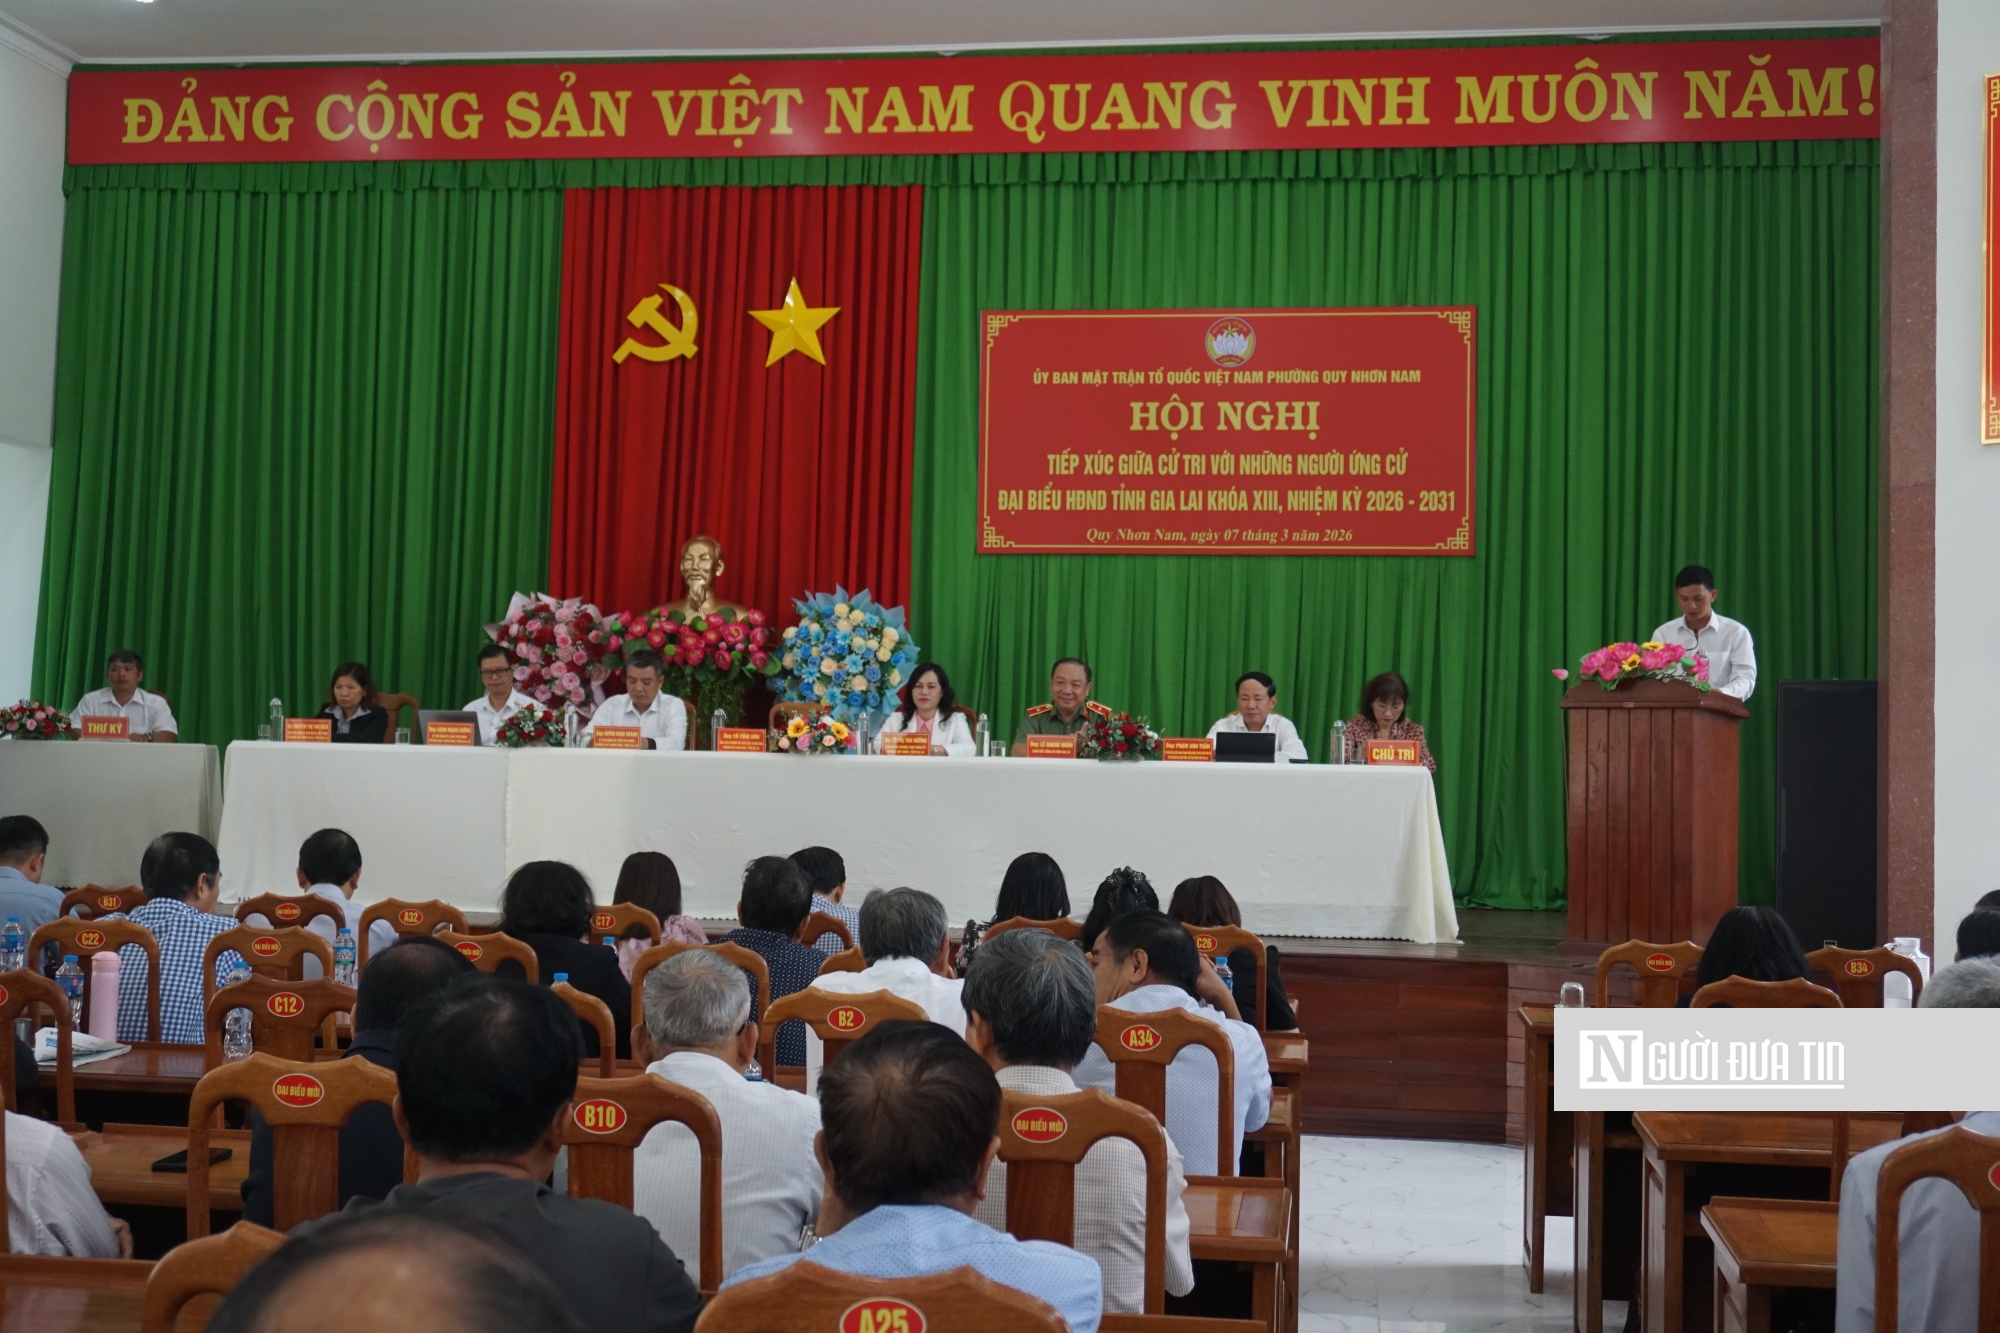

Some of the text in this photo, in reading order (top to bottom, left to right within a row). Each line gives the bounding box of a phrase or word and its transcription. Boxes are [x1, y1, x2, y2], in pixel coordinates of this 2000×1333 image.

[123, 54, 1875, 153] ĐẢNG CỘNG SẢN VIỆT NAM QUANG VINH MUÔN NĂM!
[1033, 367, 1421, 387] ỦY BAN MẶT TRẬN TỔ QUỐC VIỆT NAM PHƯỜNG QUY NHƠN NAM
[1130, 394, 1321, 440] HỘI NGHỊ
[1047, 447, 1408, 475] TIẾP XÚC GIỮA CỬ TRI VỚI NHỮNG NGƯỜI ỨNG CỬ
[998, 489, 1023, 515] ĐẠI
[1028, 482, 1061, 511] BIỂU
[1066, 489, 1107, 511] HĐND
[1111, 483, 1146, 511] TỈNH
[1150, 489, 1175, 511] GIA
[1180, 489, 1202, 511] LAI
[1207, 485, 1248, 511] KHÓA
[1253, 489, 1283, 514] XIII,
[1288, 486, 1338, 516] NHIỆM
[1343, 486, 1362, 511] KỲ
[1366, 490, 1404, 512] 2026
[1419, 490, 1455, 511] 2031
[1086, 528, 1353, 545] Quy Nhơn Nam, ngày 07 tháng 3 năm 2026
[88, 722, 108, 734] THƯ
[1372, 745, 1415, 761] CHỦ TRÌ
[103, 897, 116, 907] B31
[404, 911, 418, 922] A32
[596, 915, 610, 926] C17
[82, 933, 99, 945] C22
[1197, 938, 1212, 948] C26
[1851, 962, 1868, 973] B34
[274, 997, 297, 1013] C12
[838, 1010, 854, 1027] B2
[1130, 1030, 1153, 1046] A34
[585, 1105, 616, 1128] B10
[859, 1308, 909, 1333] A25
